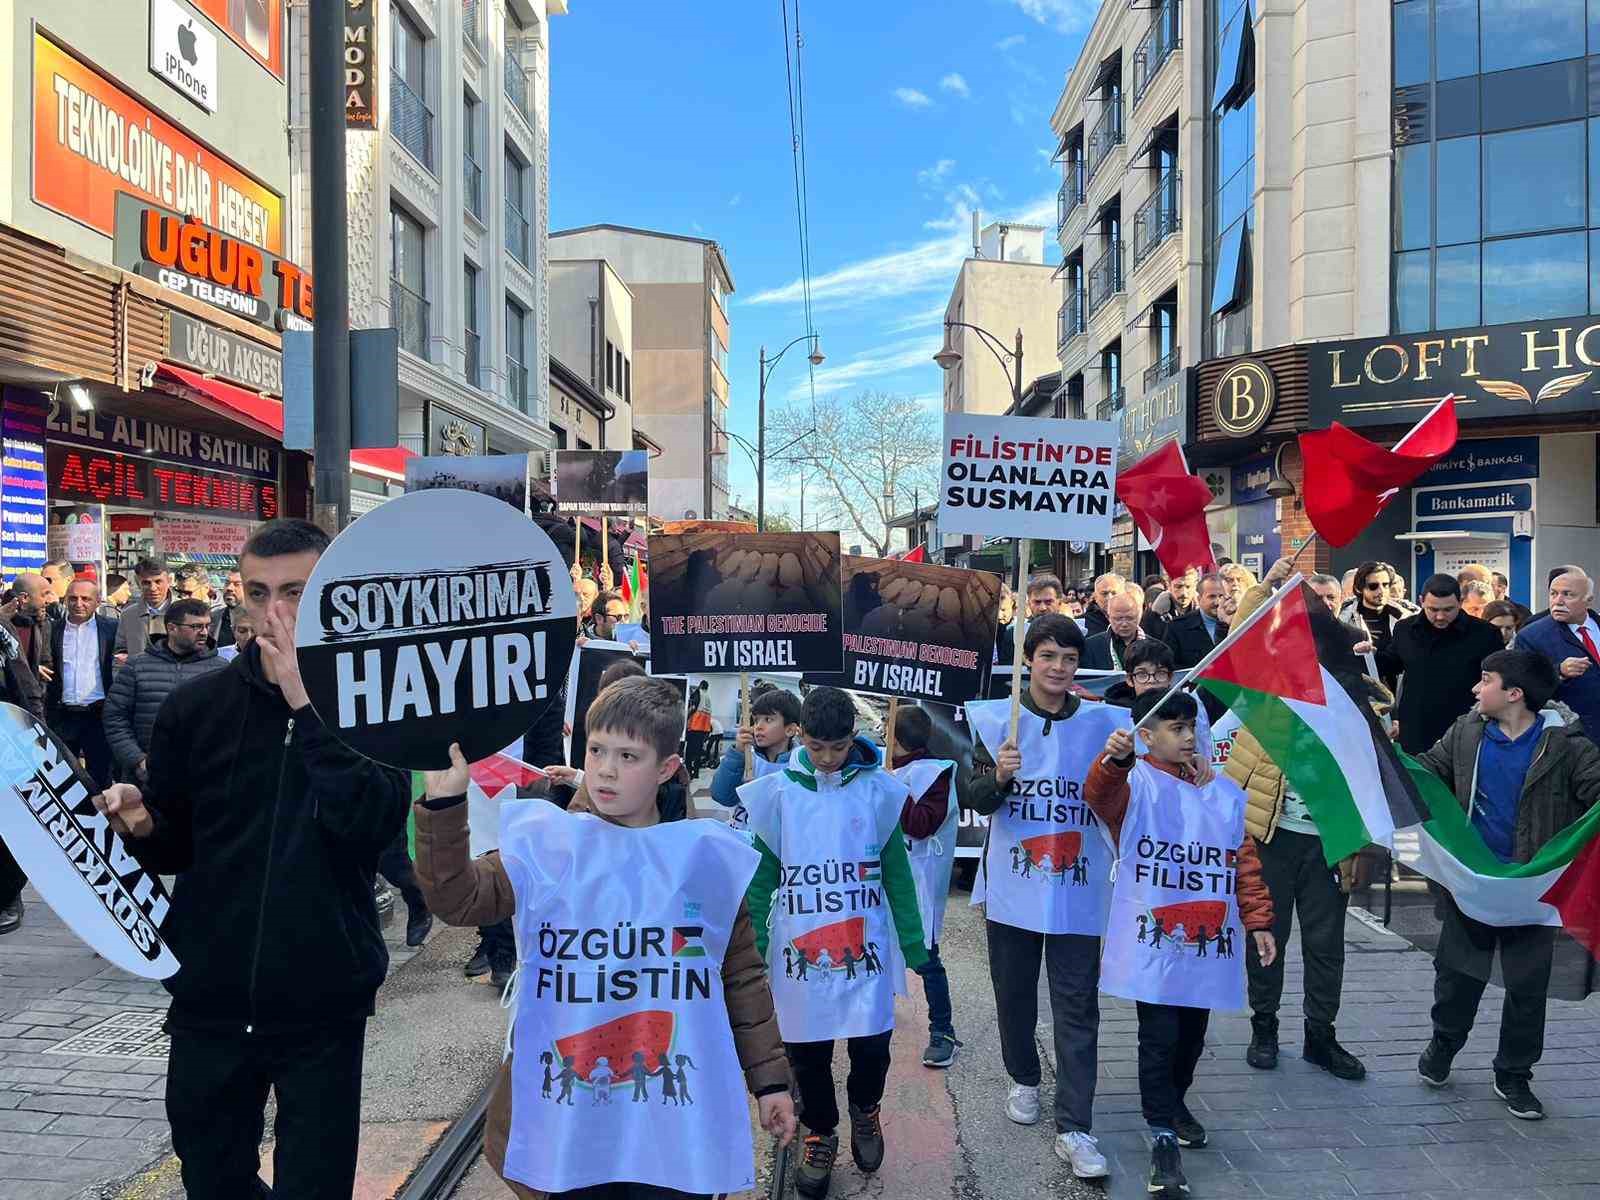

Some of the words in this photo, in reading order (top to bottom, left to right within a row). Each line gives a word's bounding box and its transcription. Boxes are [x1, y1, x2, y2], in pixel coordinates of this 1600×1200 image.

[166, 53, 207, 100] iPhone
[344, 25, 368, 108] MODA
[142, 209, 264, 297] UĞUR
[158, 268, 187, 292] CEP
[189, 279, 258, 317] TELEFONU
[186, 321, 230, 373] UĞUR
[1327, 334, 1489, 389] LOFT
[112, 415, 192, 457] ALINIR
[199, 437, 270, 473] SATILIR
[950, 432, 1112, 466] FİLİSTİN'DE
[1477, 454, 1523, 467] BANKASI
[947, 462, 1109, 489] OLANLARA
[946, 486, 1107, 515] SUSMAYIN
[1431, 493, 1514, 510] Bankamatik
[331, 571, 542, 634] SOYKIRIMA
[661, 616, 685, 635] THE
[687, 615, 765, 634] PALESTINIAN
[767, 614, 828, 633] GENOCIDE
[704, 640, 728, 667] BY
[733, 640, 796, 666] ISRAEL
[843, 633, 918, 660] PALESTINIAN
[919, 643, 978, 669] GENOCIDE
[336, 631, 548, 728] HAYIR!
[854, 660, 879, 687] BY
[882, 663, 943, 696] ISRAEL
[10, 750, 157, 953] SOYKIRIM
[1137, 834, 1222, 867] ÖZGÜR
[1136, 862, 1237, 895] FİLİSTİ
[782, 884, 880, 914] İLİSTİN
[538, 921, 665, 960] ÖZGÜR
[536, 961, 711, 1003] FİLİSTİN
